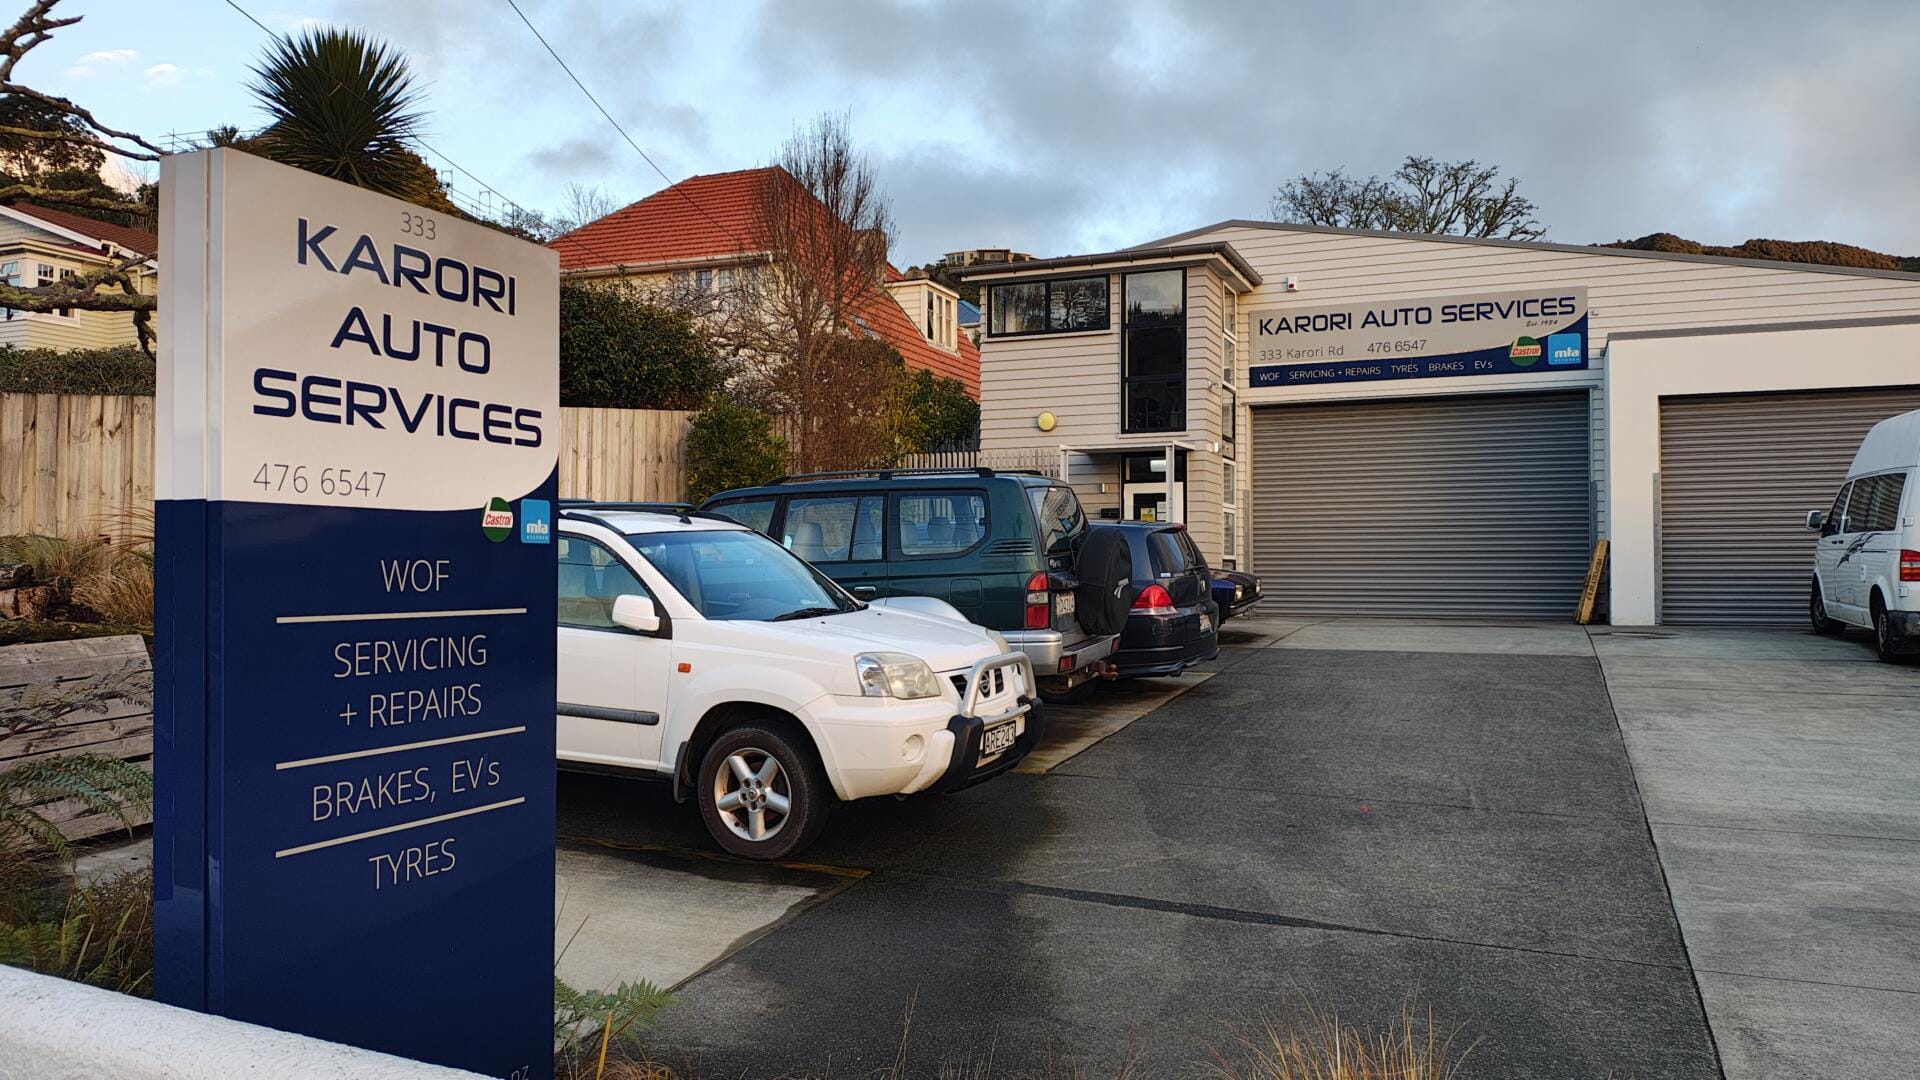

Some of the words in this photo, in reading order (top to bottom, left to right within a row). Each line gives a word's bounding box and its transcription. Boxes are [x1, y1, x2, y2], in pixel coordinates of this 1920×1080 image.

[401, 211, 436, 240] 333
[297, 217, 516, 316] KARORI
[1259, 312, 1352, 336] KARORI
[1361, 306, 1432, 329] AUTO
[1441, 297, 1575, 323] SERVICES
[330, 306, 491, 375] AUTO
[1259, 349, 1282, 361] 333
[1286, 346, 1323, 359] Karori
[1328, 345, 1344, 356] Rd
[1367, 341, 1391, 353] 476
[1394, 339, 1427, 352] 6547
[1512, 347, 1540, 356] Castrol
[1259, 371, 1281, 381] WOF
[1289, 368, 1335, 380] SERVICING
[1345, 366, 1382, 377] REPAIRS
[1391, 364, 1419, 374] TYRES
[1428, 361, 1465, 372] BRAKES
[1474, 360, 1493, 369] EVs
[253, 367, 543, 448] SERVICES
[253, 462, 309, 493] 476
[320, 467, 387, 497] 6547
[485, 513, 512, 526] Castrol
[380, 559, 450, 593] WOF
[333, 634, 487, 678] SERVICING
[339, 703, 358, 725] +
[369, 683, 482, 728] REPAIRS
[312, 767, 437, 822] BRAKES,
[452, 756, 500, 793] EVs
[368, 838, 456, 890] TYRES
